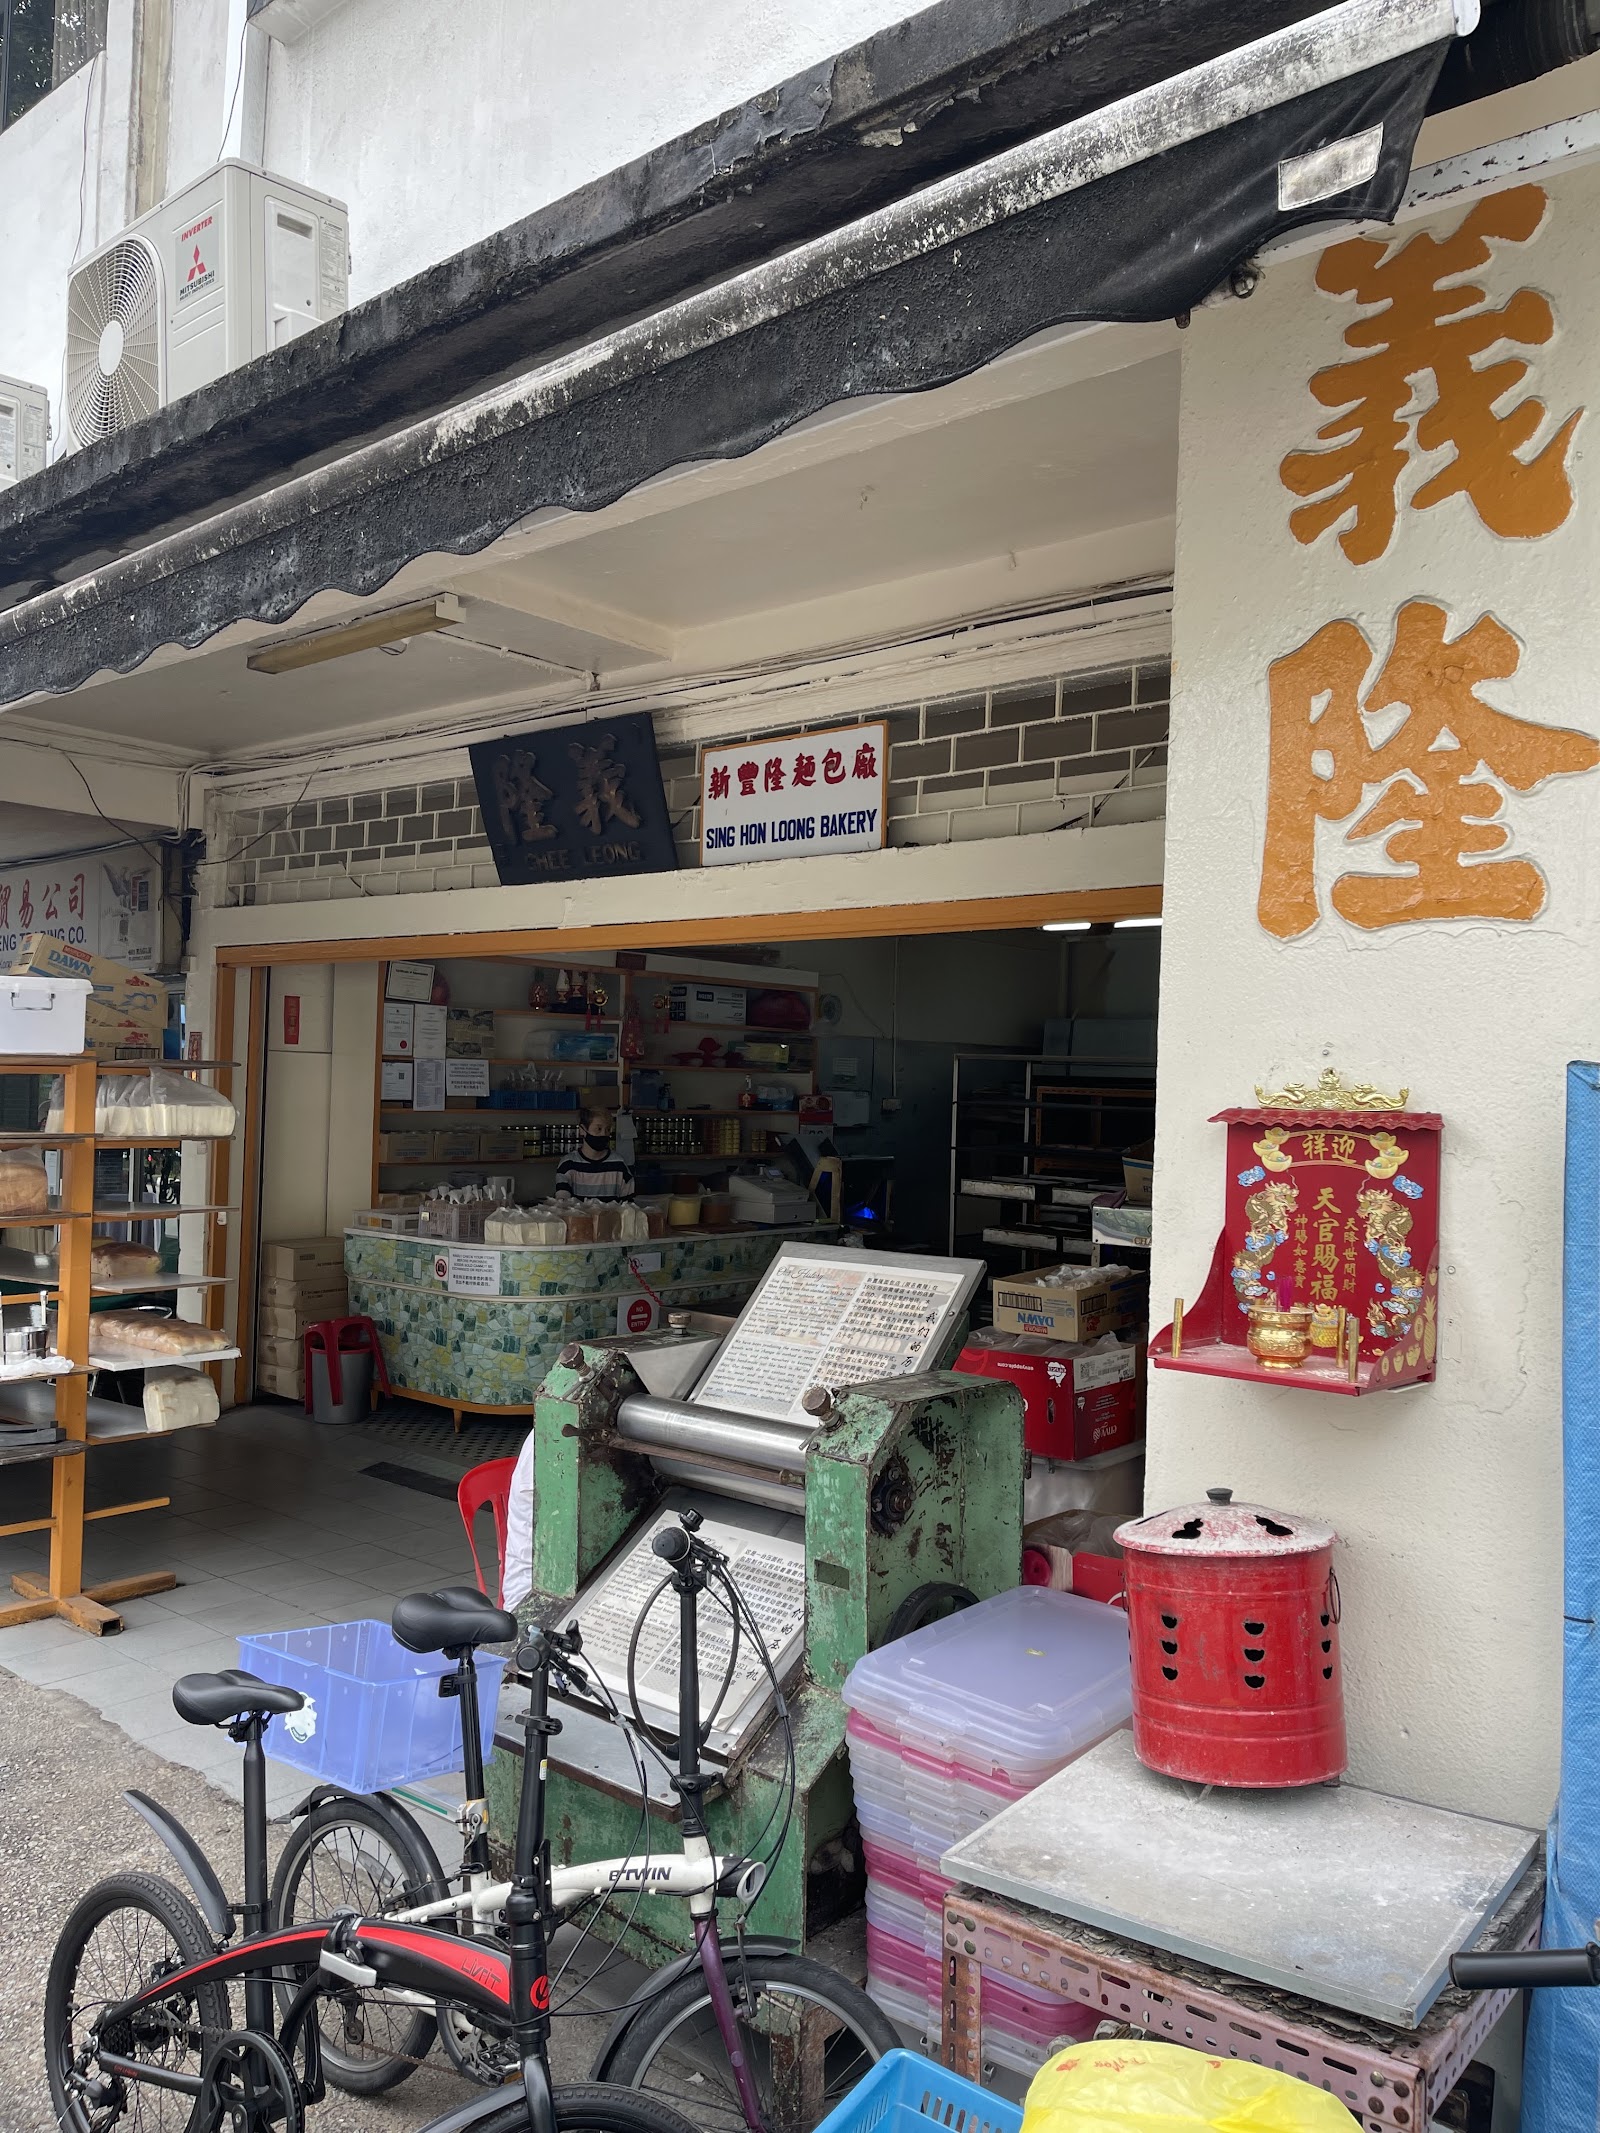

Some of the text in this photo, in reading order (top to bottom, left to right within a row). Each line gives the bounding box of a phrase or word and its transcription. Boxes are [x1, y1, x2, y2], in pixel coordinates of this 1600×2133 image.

[181, 216, 213, 242] INVERTER
[179, 270, 215, 296] MITSUBISHI
[705, 808, 879, 849] SING HON LOONG BAKERY
[584, 840, 641, 864] LEONG
[68, 926, 87, 944] CO.
[48, 949, 95, 977] DAWN
[1310, 1187, 1341, 1302] 天官賜福
[631, 1320, 647, 1328] ENTRY
[1017, 1312, 1054, 1327] DAWN
[997, 1362, 1034, 1371] envyapple.com
